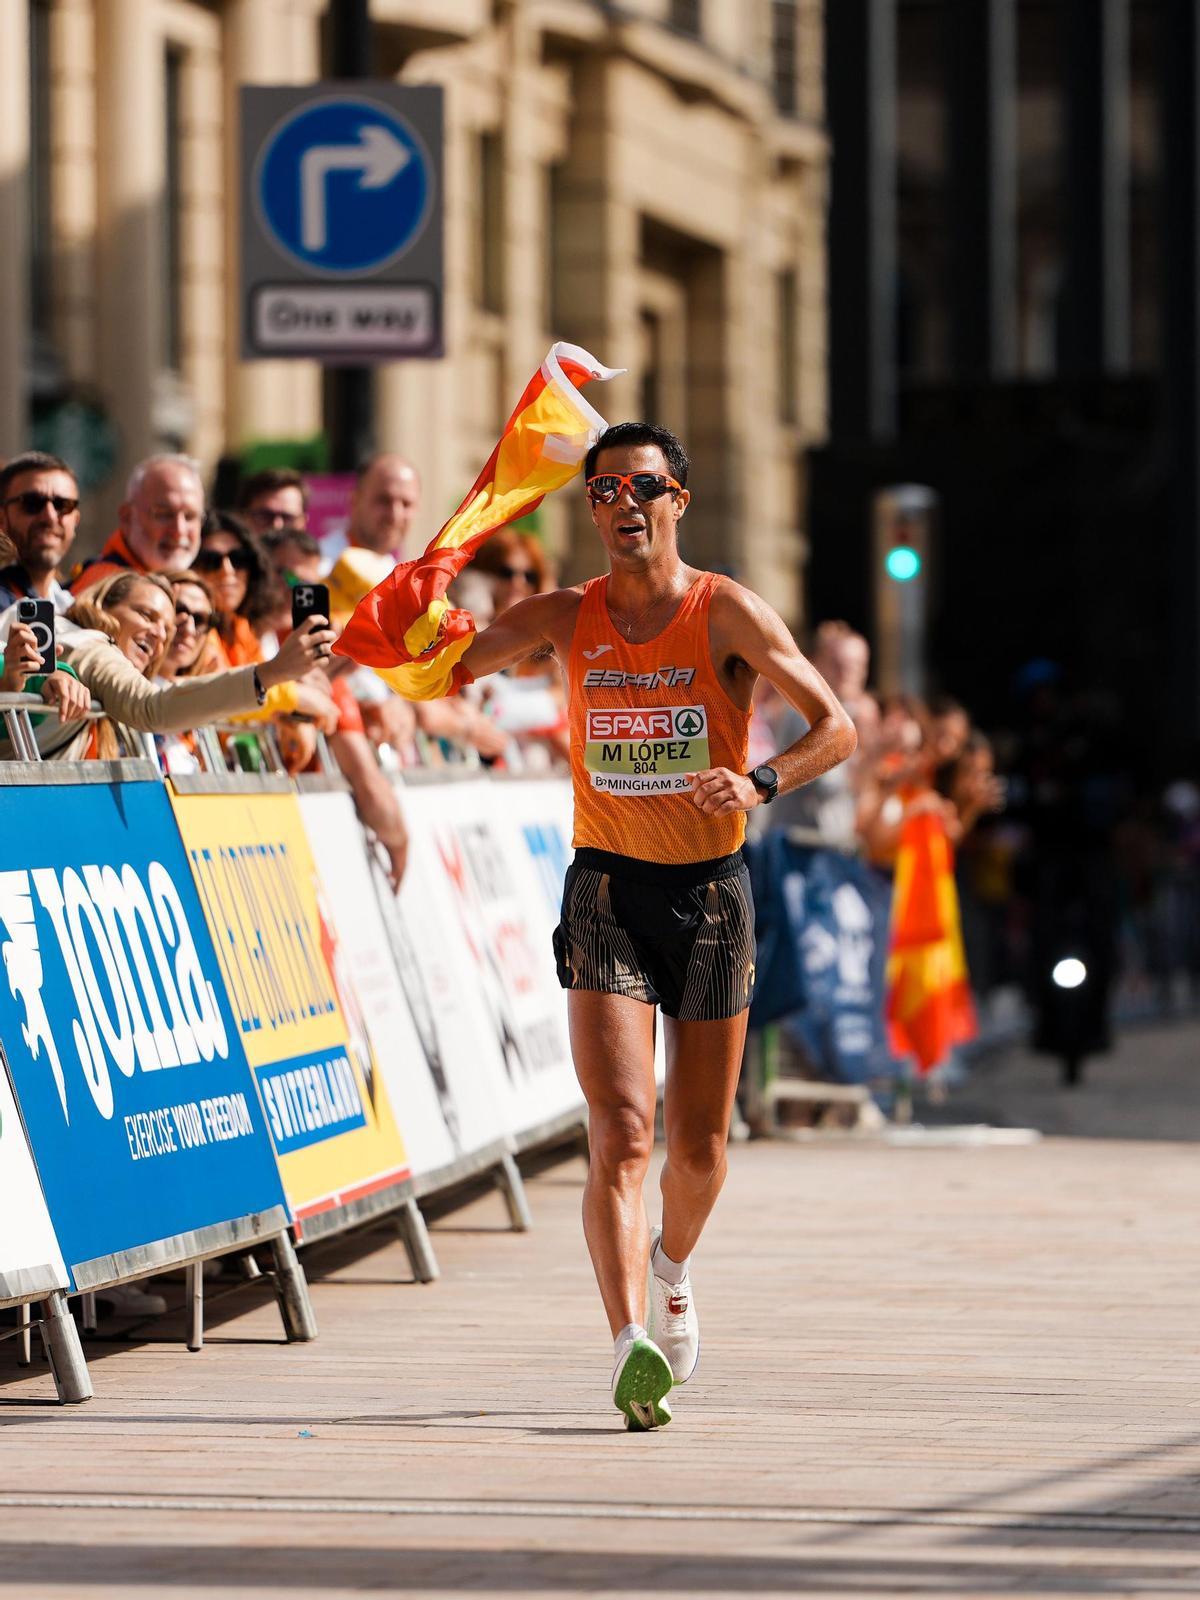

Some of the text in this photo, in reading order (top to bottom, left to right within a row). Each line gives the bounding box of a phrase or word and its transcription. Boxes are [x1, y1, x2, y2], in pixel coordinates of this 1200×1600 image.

[268, 299, 419, 333] One way
[583, 666, 696, 689] ESPAÑA
[592, 713, 671, 736] SPAR
[602, 739, 691, 761] M LÓPEZ
[633, 762, 657, 774] 804
[595, 776, 671, 790] BMINGHAM
[262, 1056, 362, 1142] SWITZERLAND
[124, 1092, 254, 1161] EXERCISE YOUR FREEDOM
